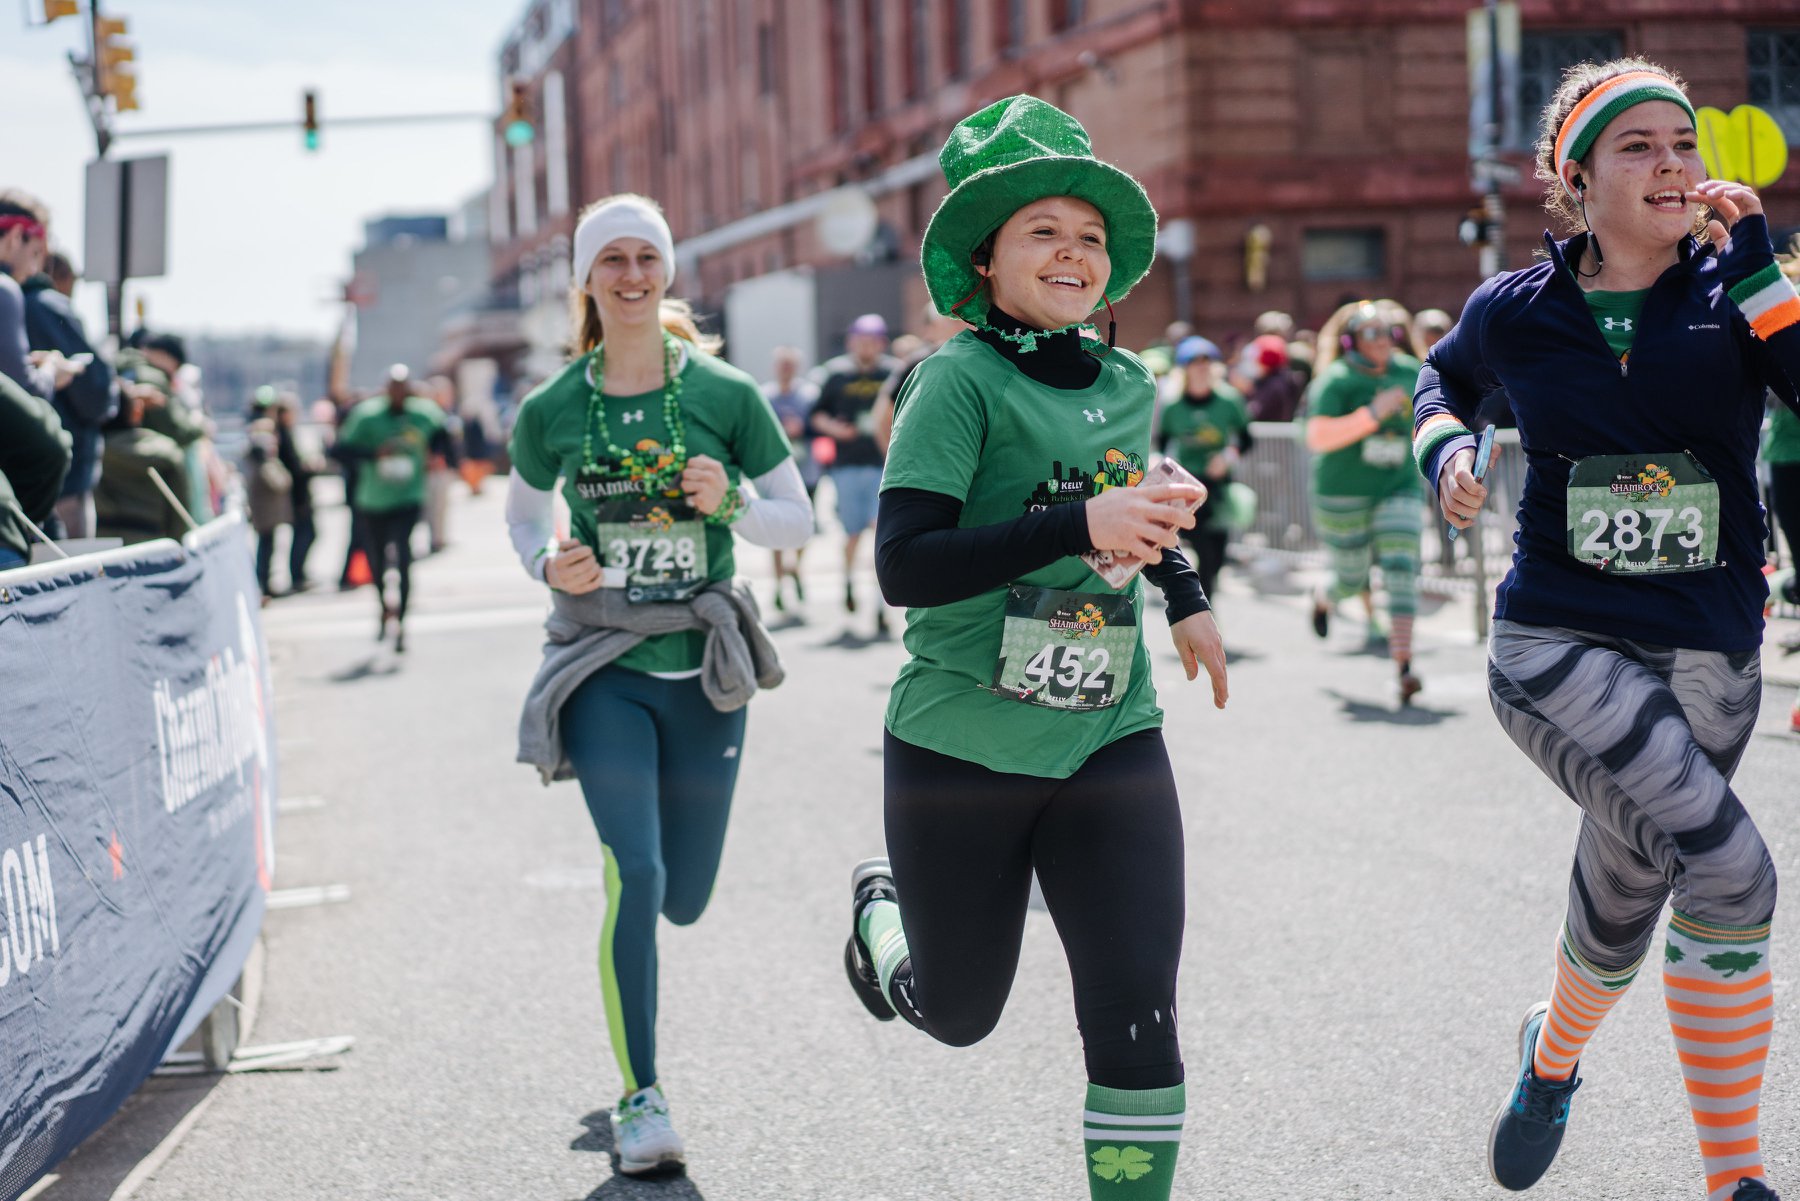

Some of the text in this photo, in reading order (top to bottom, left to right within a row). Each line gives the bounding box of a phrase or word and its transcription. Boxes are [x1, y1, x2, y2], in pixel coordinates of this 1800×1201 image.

[1117, 459, 1137, 474] 2018
[1061, 481, 1083, 490] KELLY
[1611, 483, 1663, 493] SHAMROCK
[1581, 506, 1704, 552] 2873
[609, 537, 696, 570] 3728
[1050, 618, 1095, 631] SHAMROCK
[1025, 643, 1110, 689] 452
[0, 833, 59, 988] OM
